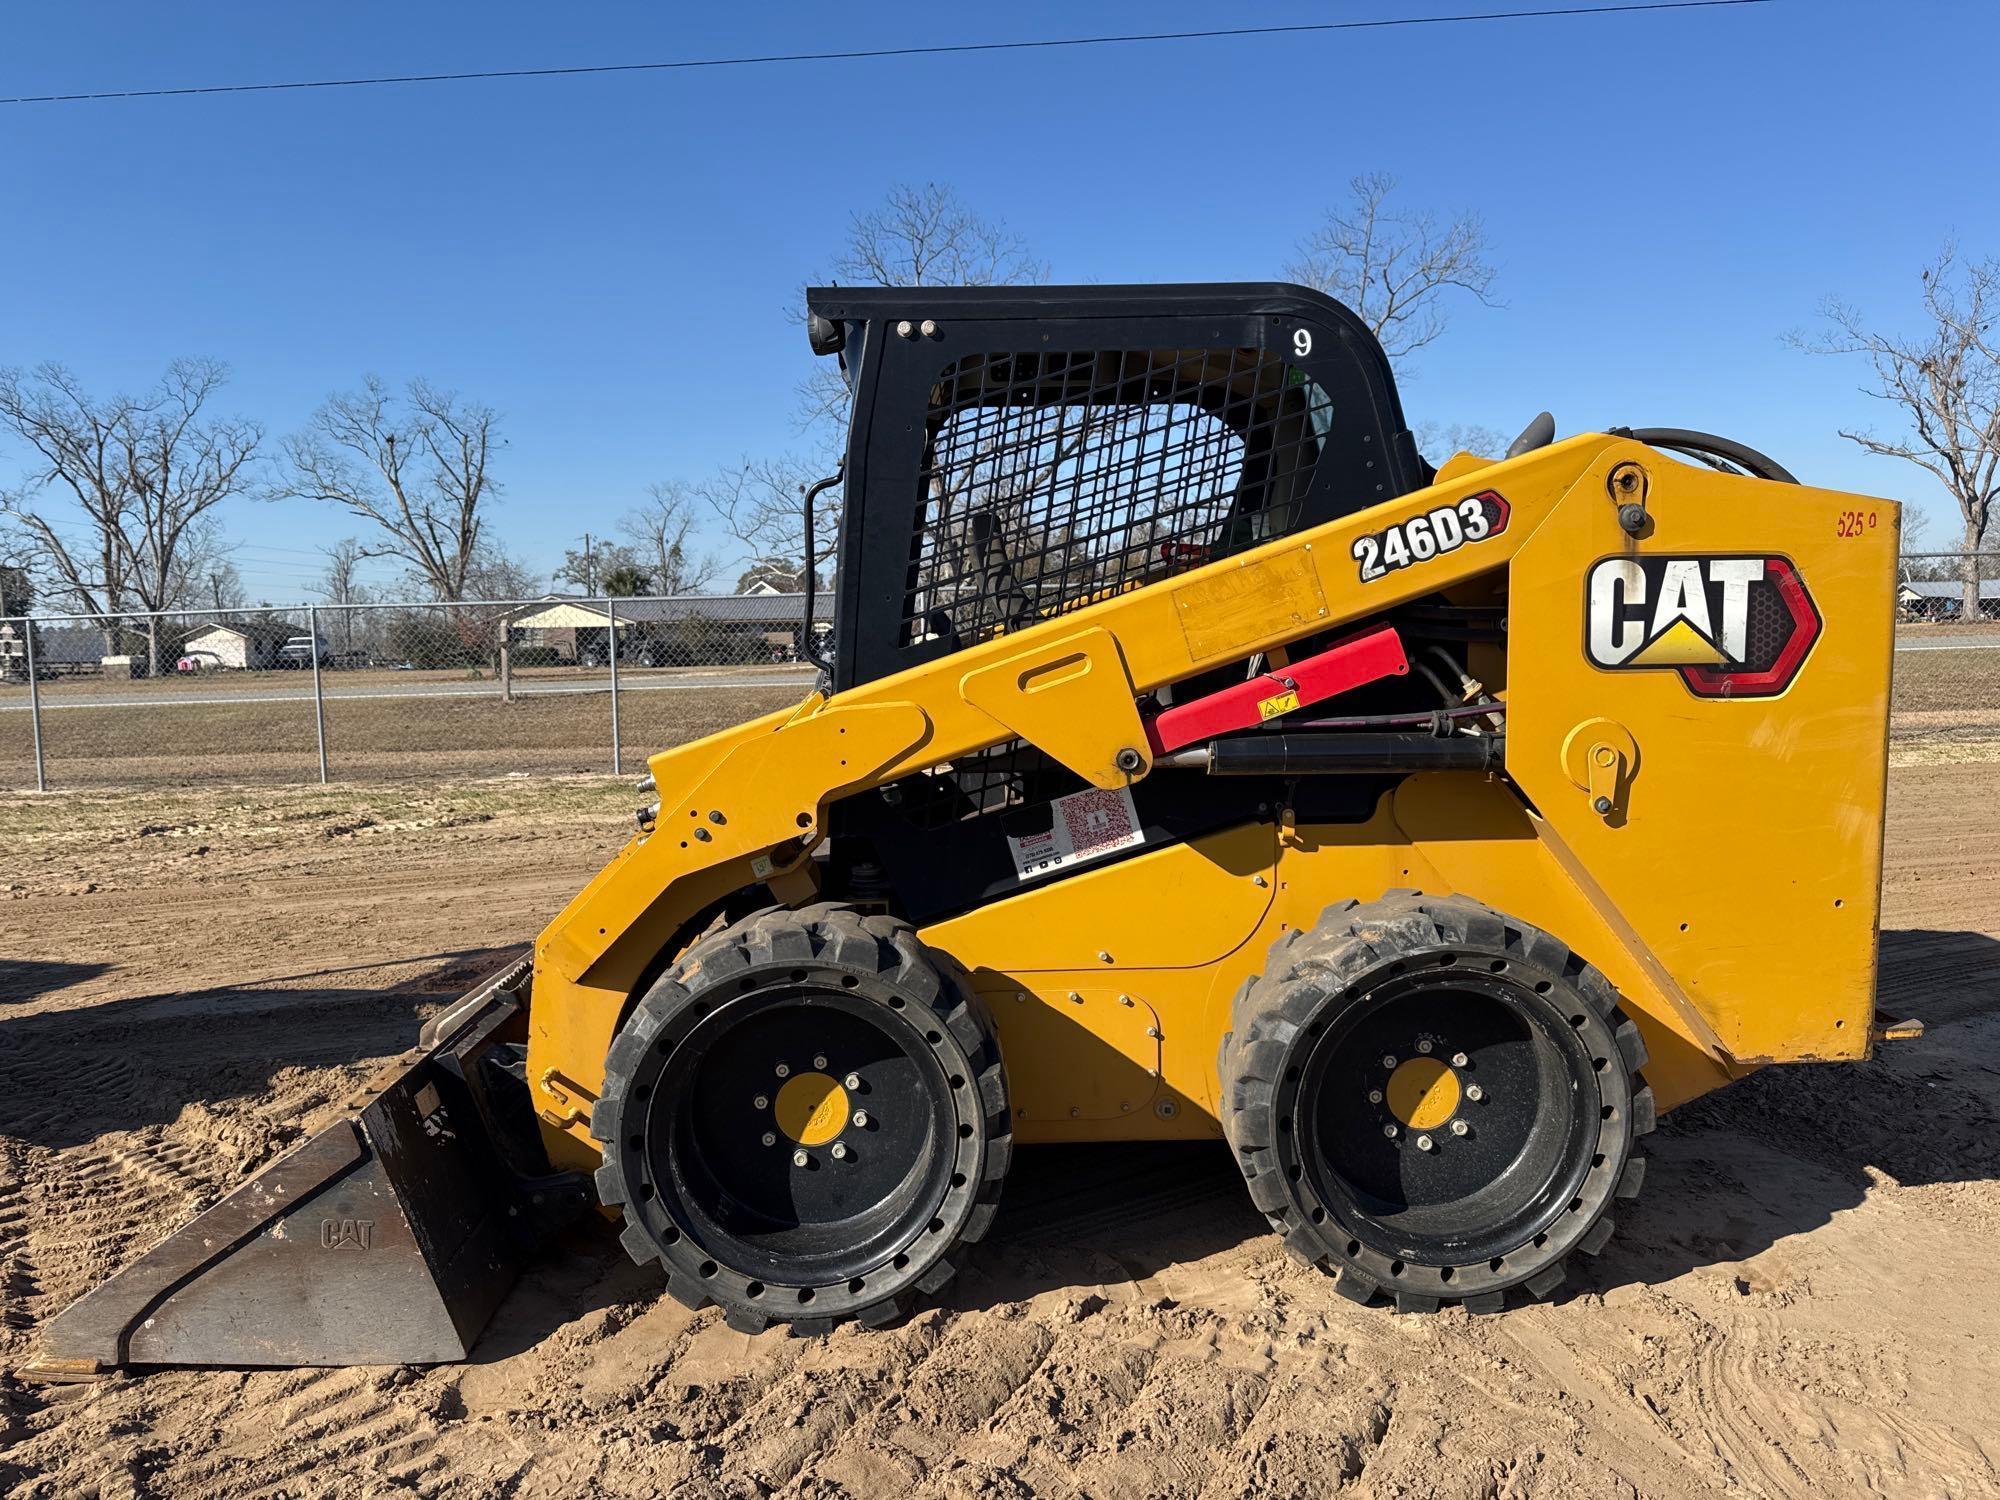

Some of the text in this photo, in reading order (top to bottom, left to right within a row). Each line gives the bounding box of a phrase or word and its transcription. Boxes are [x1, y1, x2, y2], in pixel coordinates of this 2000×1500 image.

[1293, 328, 1312, 357] 9
[1353, 498, 1490, 581] 246D3
[1590, 559, 1764, 664] CAT
[321, 1218, 375, 1249] CAT
